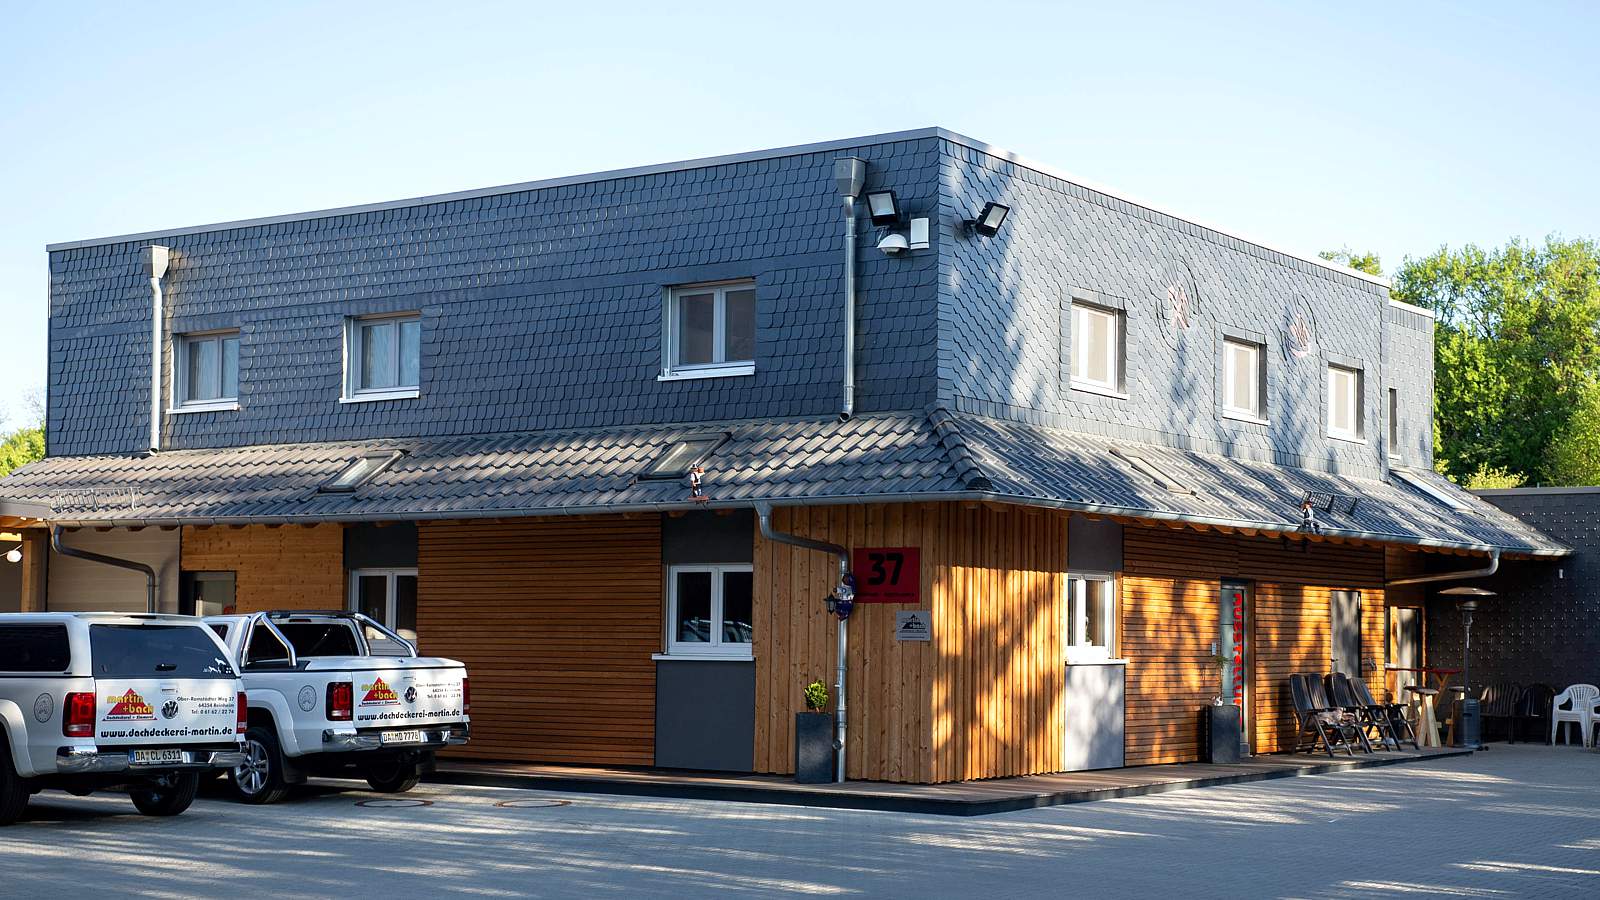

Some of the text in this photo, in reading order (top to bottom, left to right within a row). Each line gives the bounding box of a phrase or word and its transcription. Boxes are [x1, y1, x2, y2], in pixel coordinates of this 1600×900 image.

[867, 553, 904, 585] 37
[361, 681, 390, 691] martin
[106, 693, 144, 703] martin
[358, 708, 460, 720] www.dachdeckerei-martin.de
[101, 726, 233, 738] www.dachdeckerei-martin.de
[383, 733, 391, 741] DA
[135, 749, 181, 761] DA CL 6311
